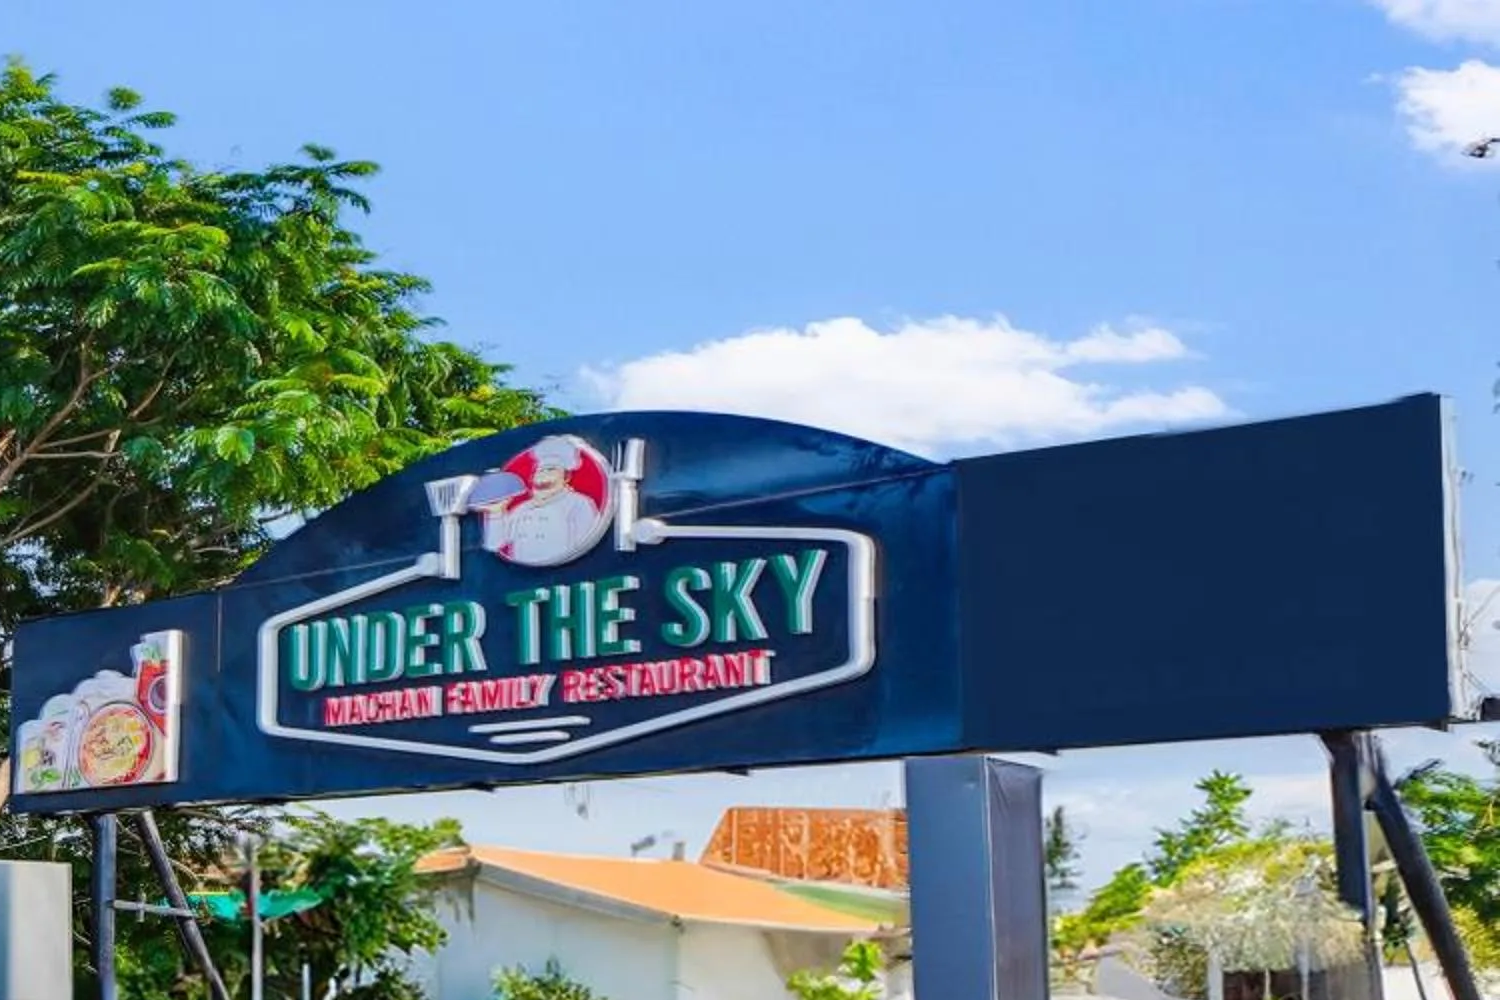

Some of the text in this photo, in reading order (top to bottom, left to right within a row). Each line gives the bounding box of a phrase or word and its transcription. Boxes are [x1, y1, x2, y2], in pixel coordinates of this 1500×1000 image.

[289, 548, 828, 691] UNDER THE SKY
[323, 648, 776, 728] MACHAN FAMILY RESTAURANT
